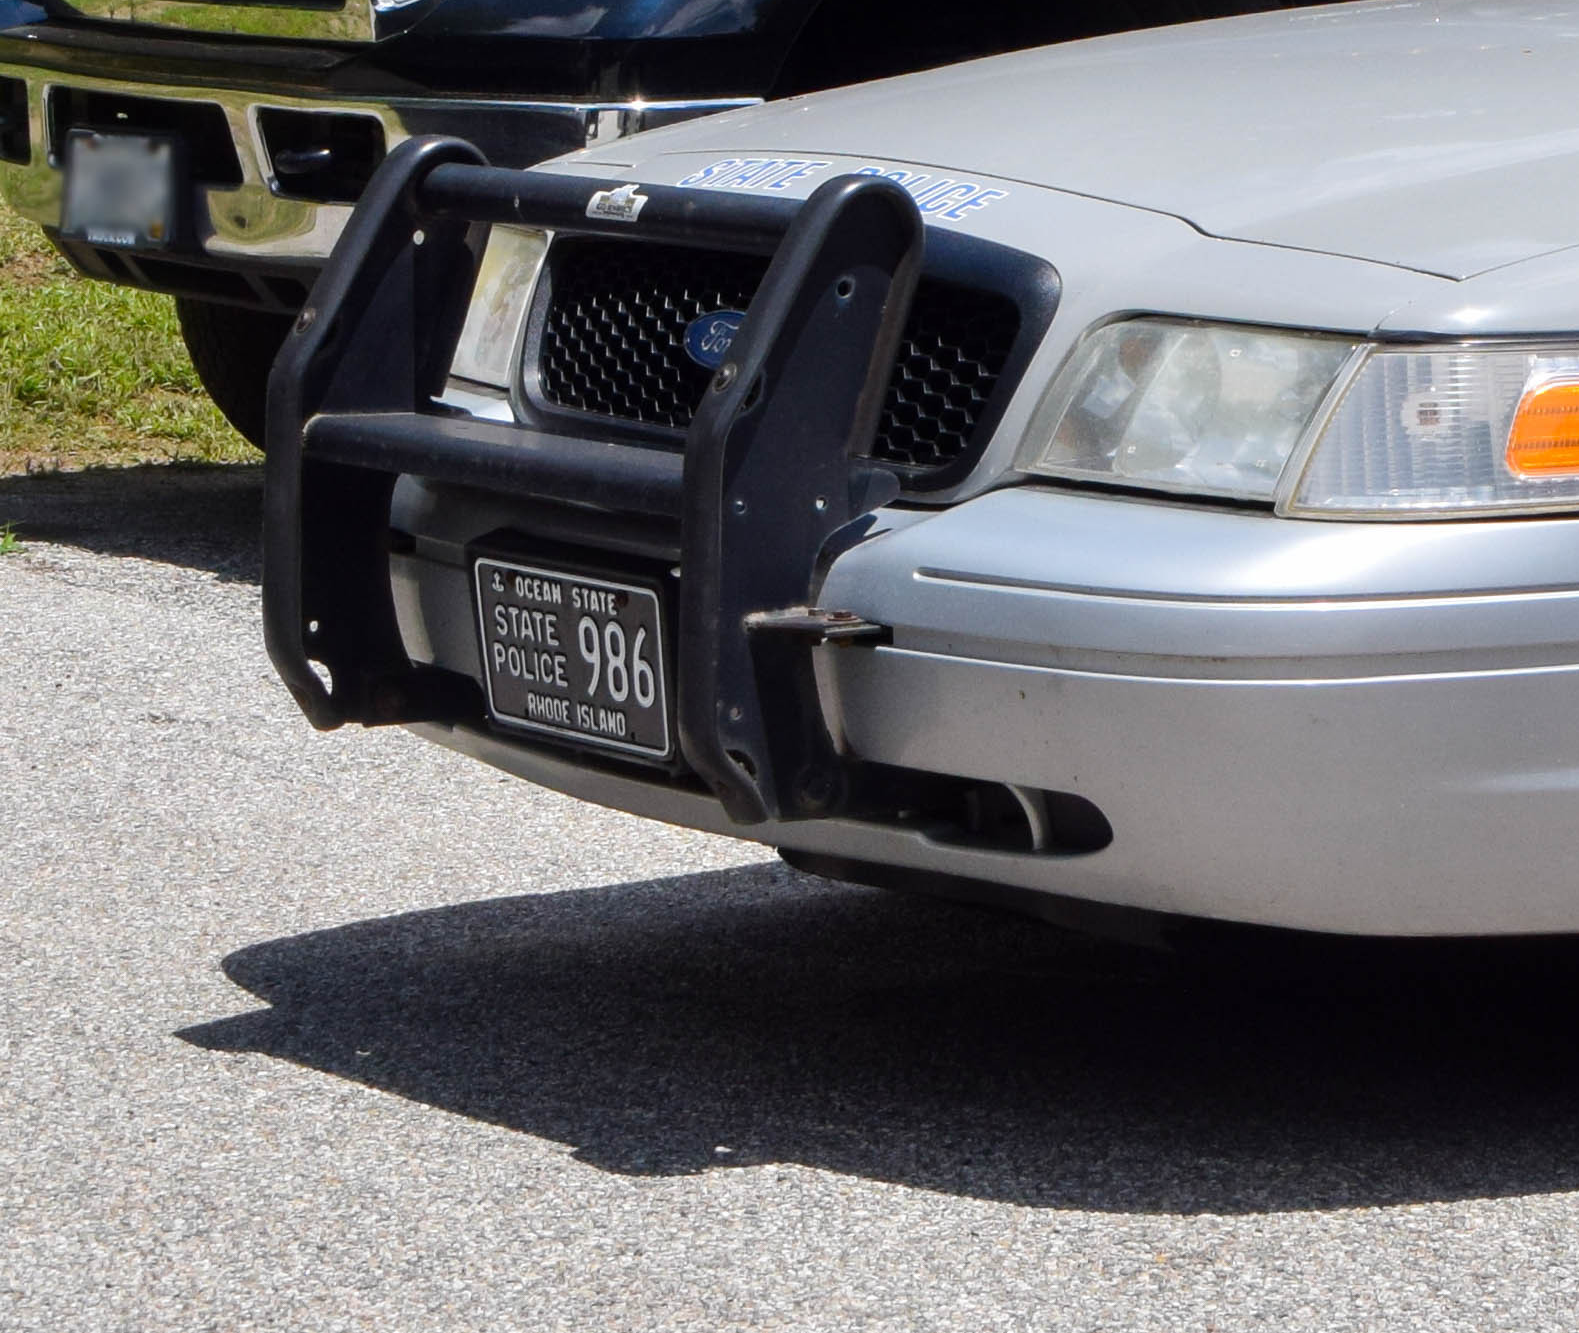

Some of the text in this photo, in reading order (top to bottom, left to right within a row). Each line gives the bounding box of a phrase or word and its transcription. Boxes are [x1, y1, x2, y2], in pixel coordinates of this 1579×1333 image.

[676, 157, 832, 190] STATE
[515, 575, 617, 616] OCEAN STATE
[495, 604, 560, 647] STATE
[493, 642, 568, 688] POLICE
[578, 616, 655, 709] 986
[527, 692, 626, 737] RHODE ISLAND
